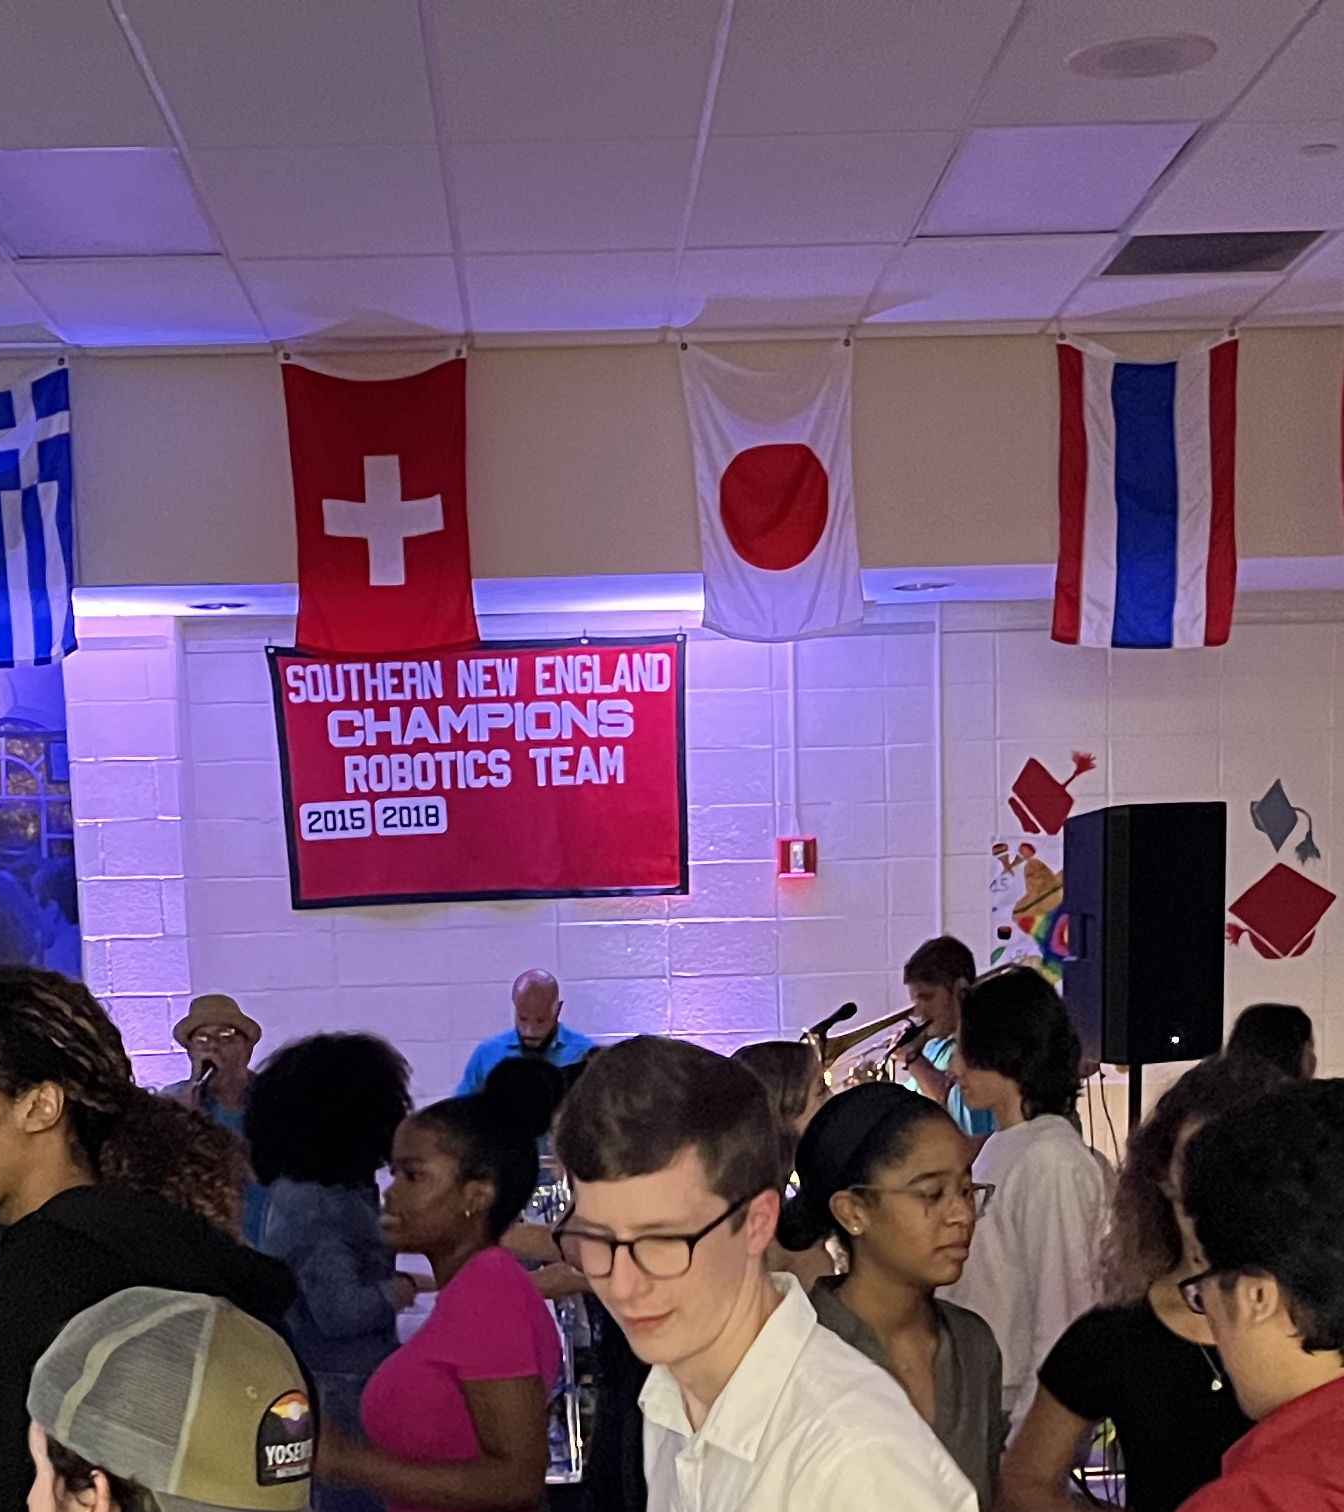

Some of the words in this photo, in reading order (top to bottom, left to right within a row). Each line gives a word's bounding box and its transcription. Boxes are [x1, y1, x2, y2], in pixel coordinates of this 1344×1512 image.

[285, 660, 443, 703] SOUTHERN
[456, 657, 519, 698] NEW
[534, 653, 671, 695] ENGLAND
[327, 700, 634, 748] CHAMPIONS
[344, 748, 513, 794] ROBOTICS
[528, 745, 625, 787] TEAM
[307, 807, 365, 833] 2015
[382, 804, 440, 828] 2018
[264, 1438, 314, 1466] YOSE
